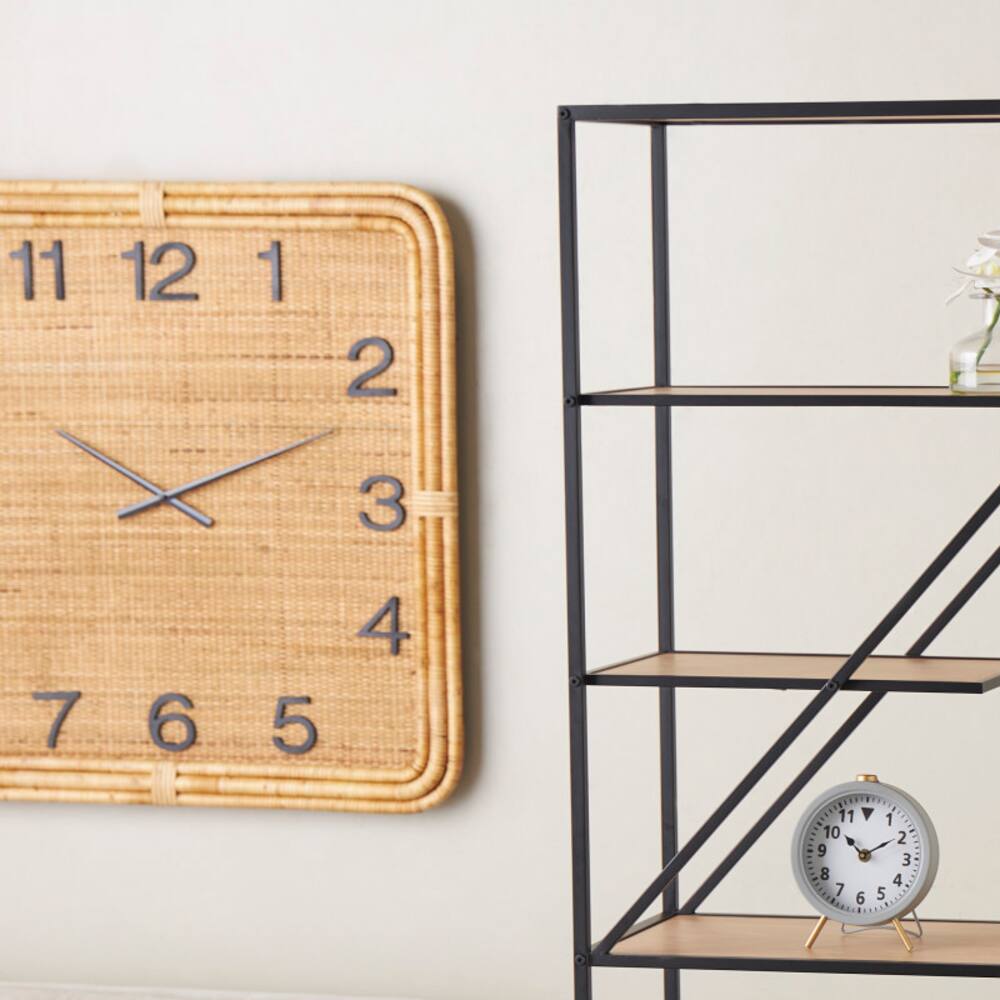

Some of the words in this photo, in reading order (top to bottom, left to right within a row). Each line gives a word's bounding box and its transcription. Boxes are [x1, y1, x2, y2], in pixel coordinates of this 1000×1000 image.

[10, 240, 64, 300] 11
[121, 240, 199, 301] 12
[257, 240, 282, 301] 1
[346, 337, 397, 397] 2
[358, 475, 405, 531] 3
[358, 596, 410, 655] 4
[32, 690, 80, 748] 7
[148, 693, 197, 752] 6
[271, 695, 317, 754] 5
[839, 809, 854, 823] 11
[886, 812, 893, 826] 1
[824, 825, 840, 839] 10
[897, 831, 906, 845] 2
[818, 844, 827, 857] 9
[902, 853, 911, 866] 3
[820, 867, 830, 880] 8
[893, 874, 902, 887] 4
[836, 883, 845, 896] 7
[877, 887, 886, 900] 5
[856, 891, 865, 904] 6
